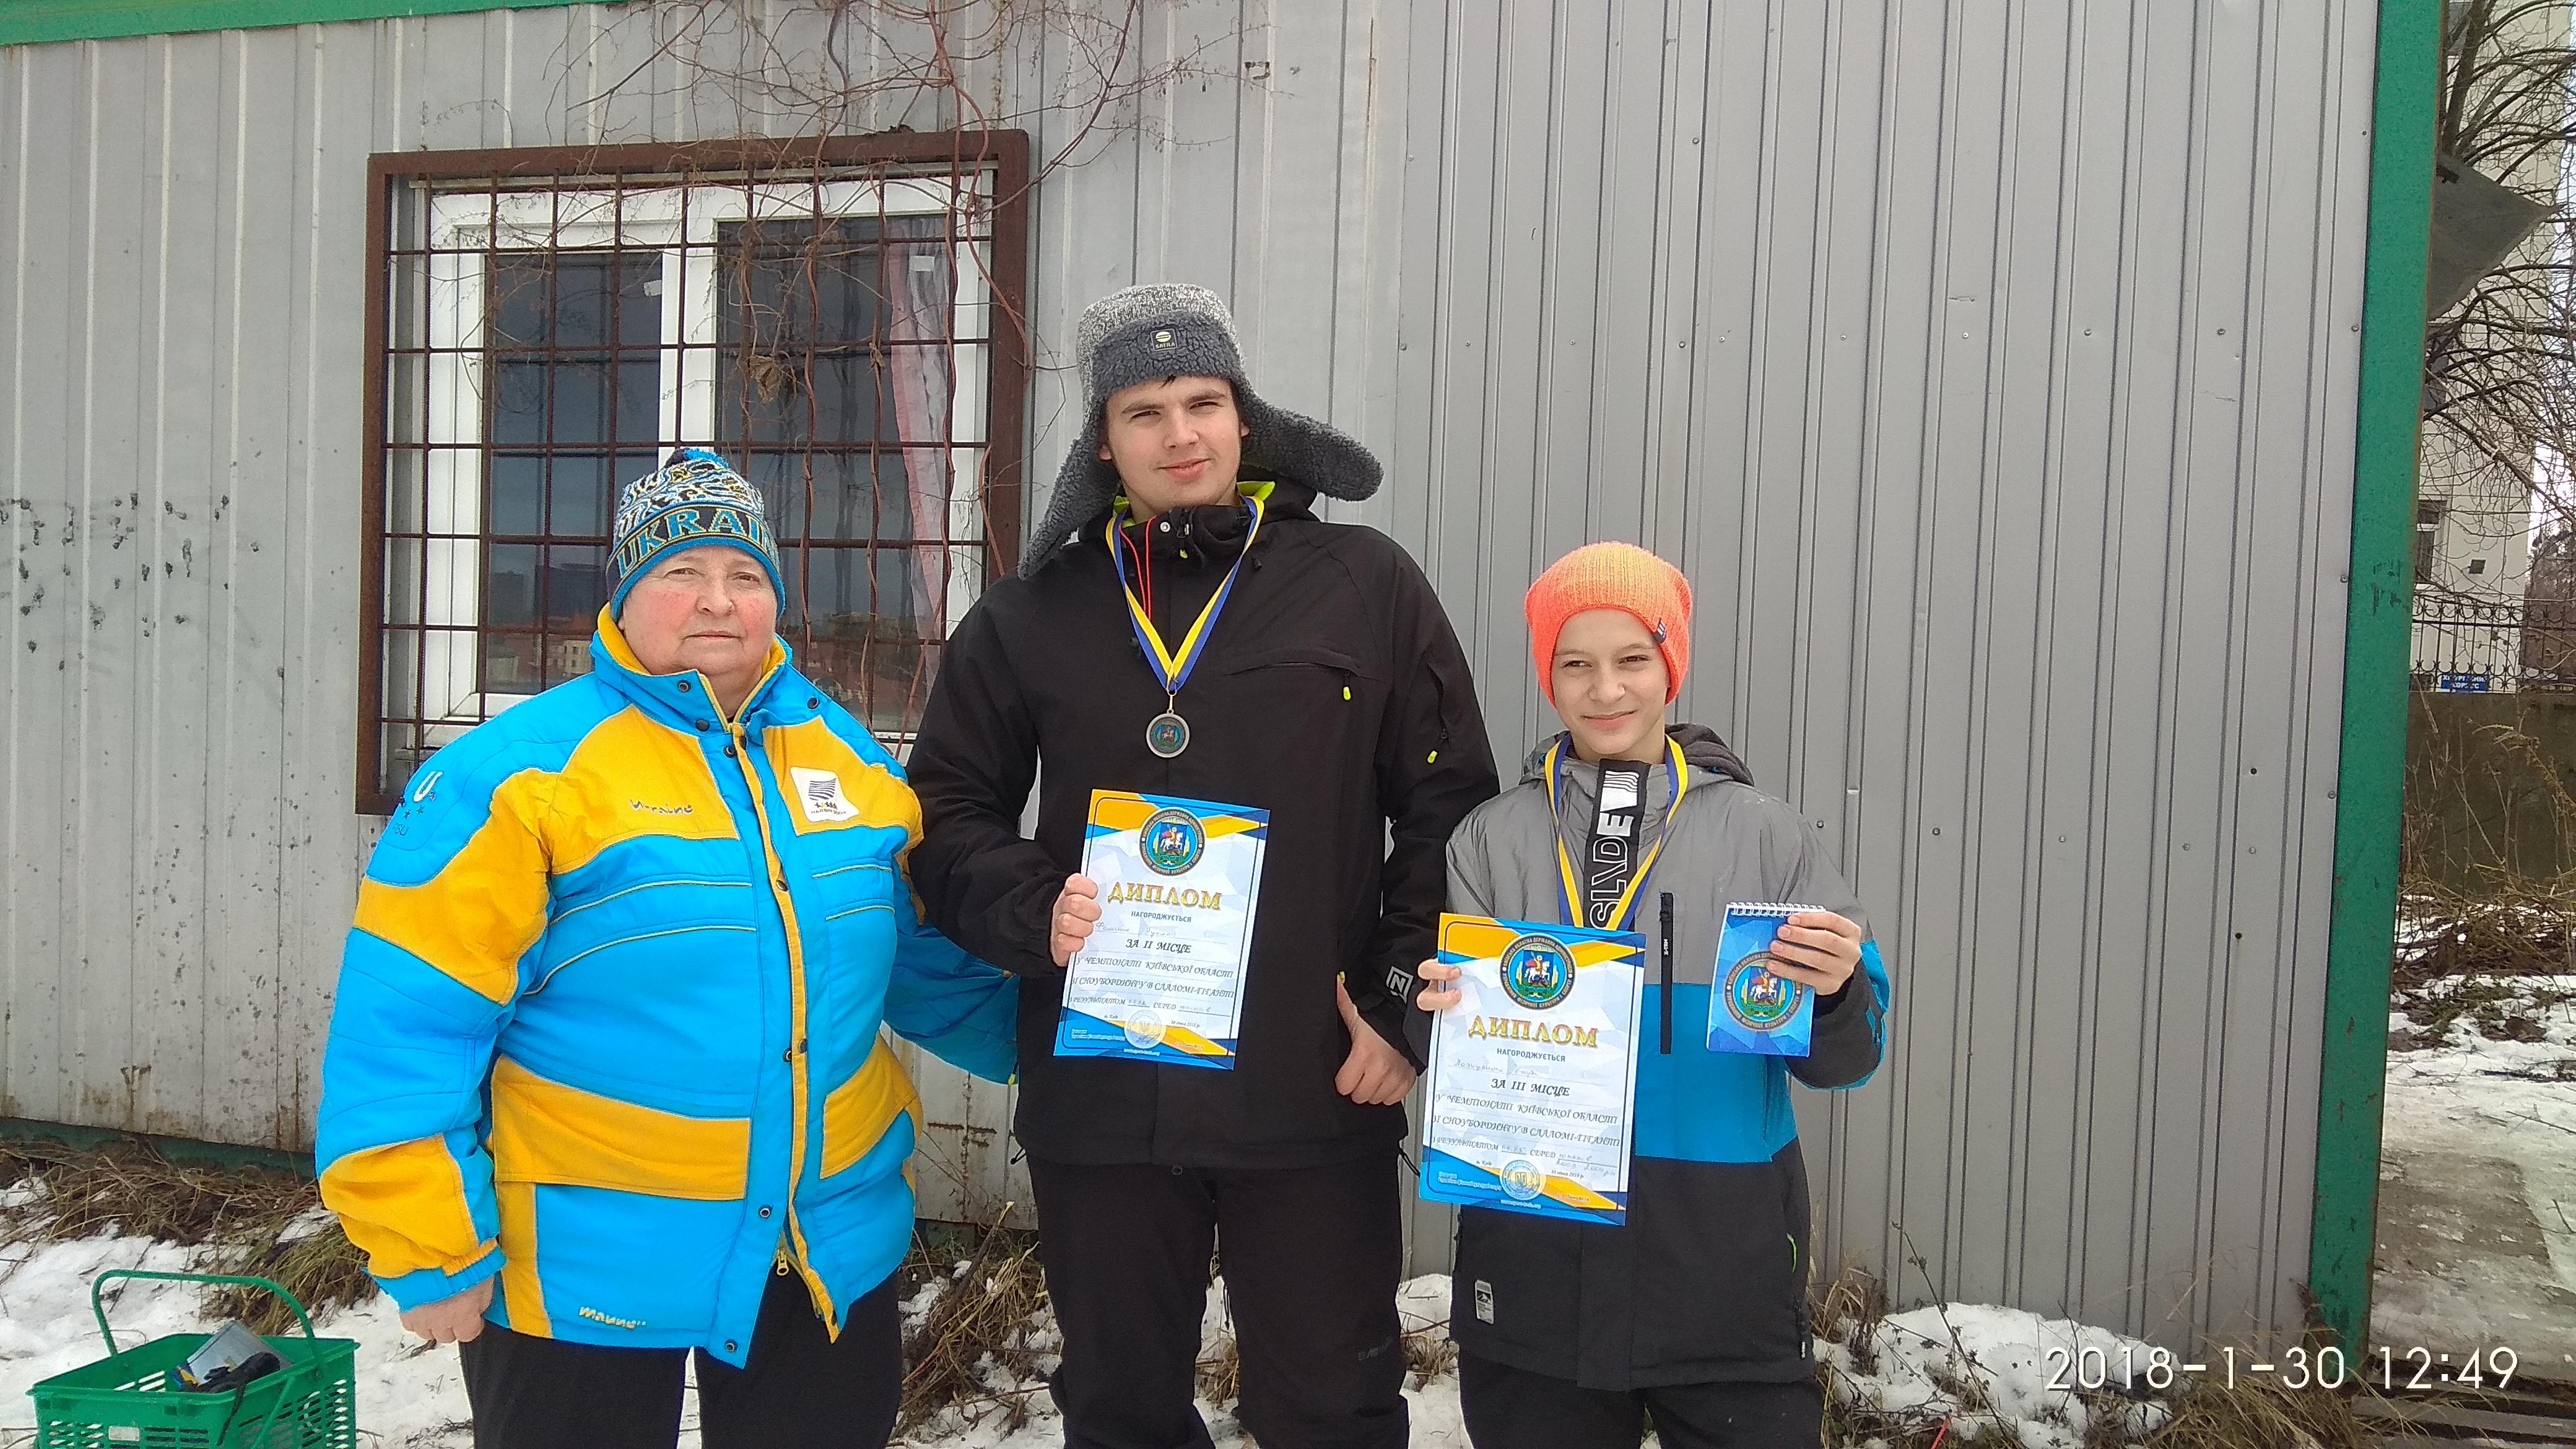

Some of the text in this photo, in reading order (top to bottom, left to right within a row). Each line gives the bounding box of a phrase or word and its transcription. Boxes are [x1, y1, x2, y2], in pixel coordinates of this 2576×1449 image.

[1107, 881, 1222, 910] ДИПЛОМ
[1131, 911, 1192, 923] НАГОРОДЖУЄТЬСЯ
[1125, 939, 1139, 948] ЗА
[1156, 942, 1192, 954] МІСЦЕ
[1154, 1002, 1177, 1010] СЕРЕД
[1468, 1015, 1599, 1048] ДИПЛОМ
[1497, 1048, 1565, 1062] НАГОРОДЖУЄТЬСЯ
[1490, 1078, 1506, 1089] ЗА
[1530, 1083, 1570, 1097] МІСЦЕ
[1530, 1149, 1556, 1159] СЕРЕД
